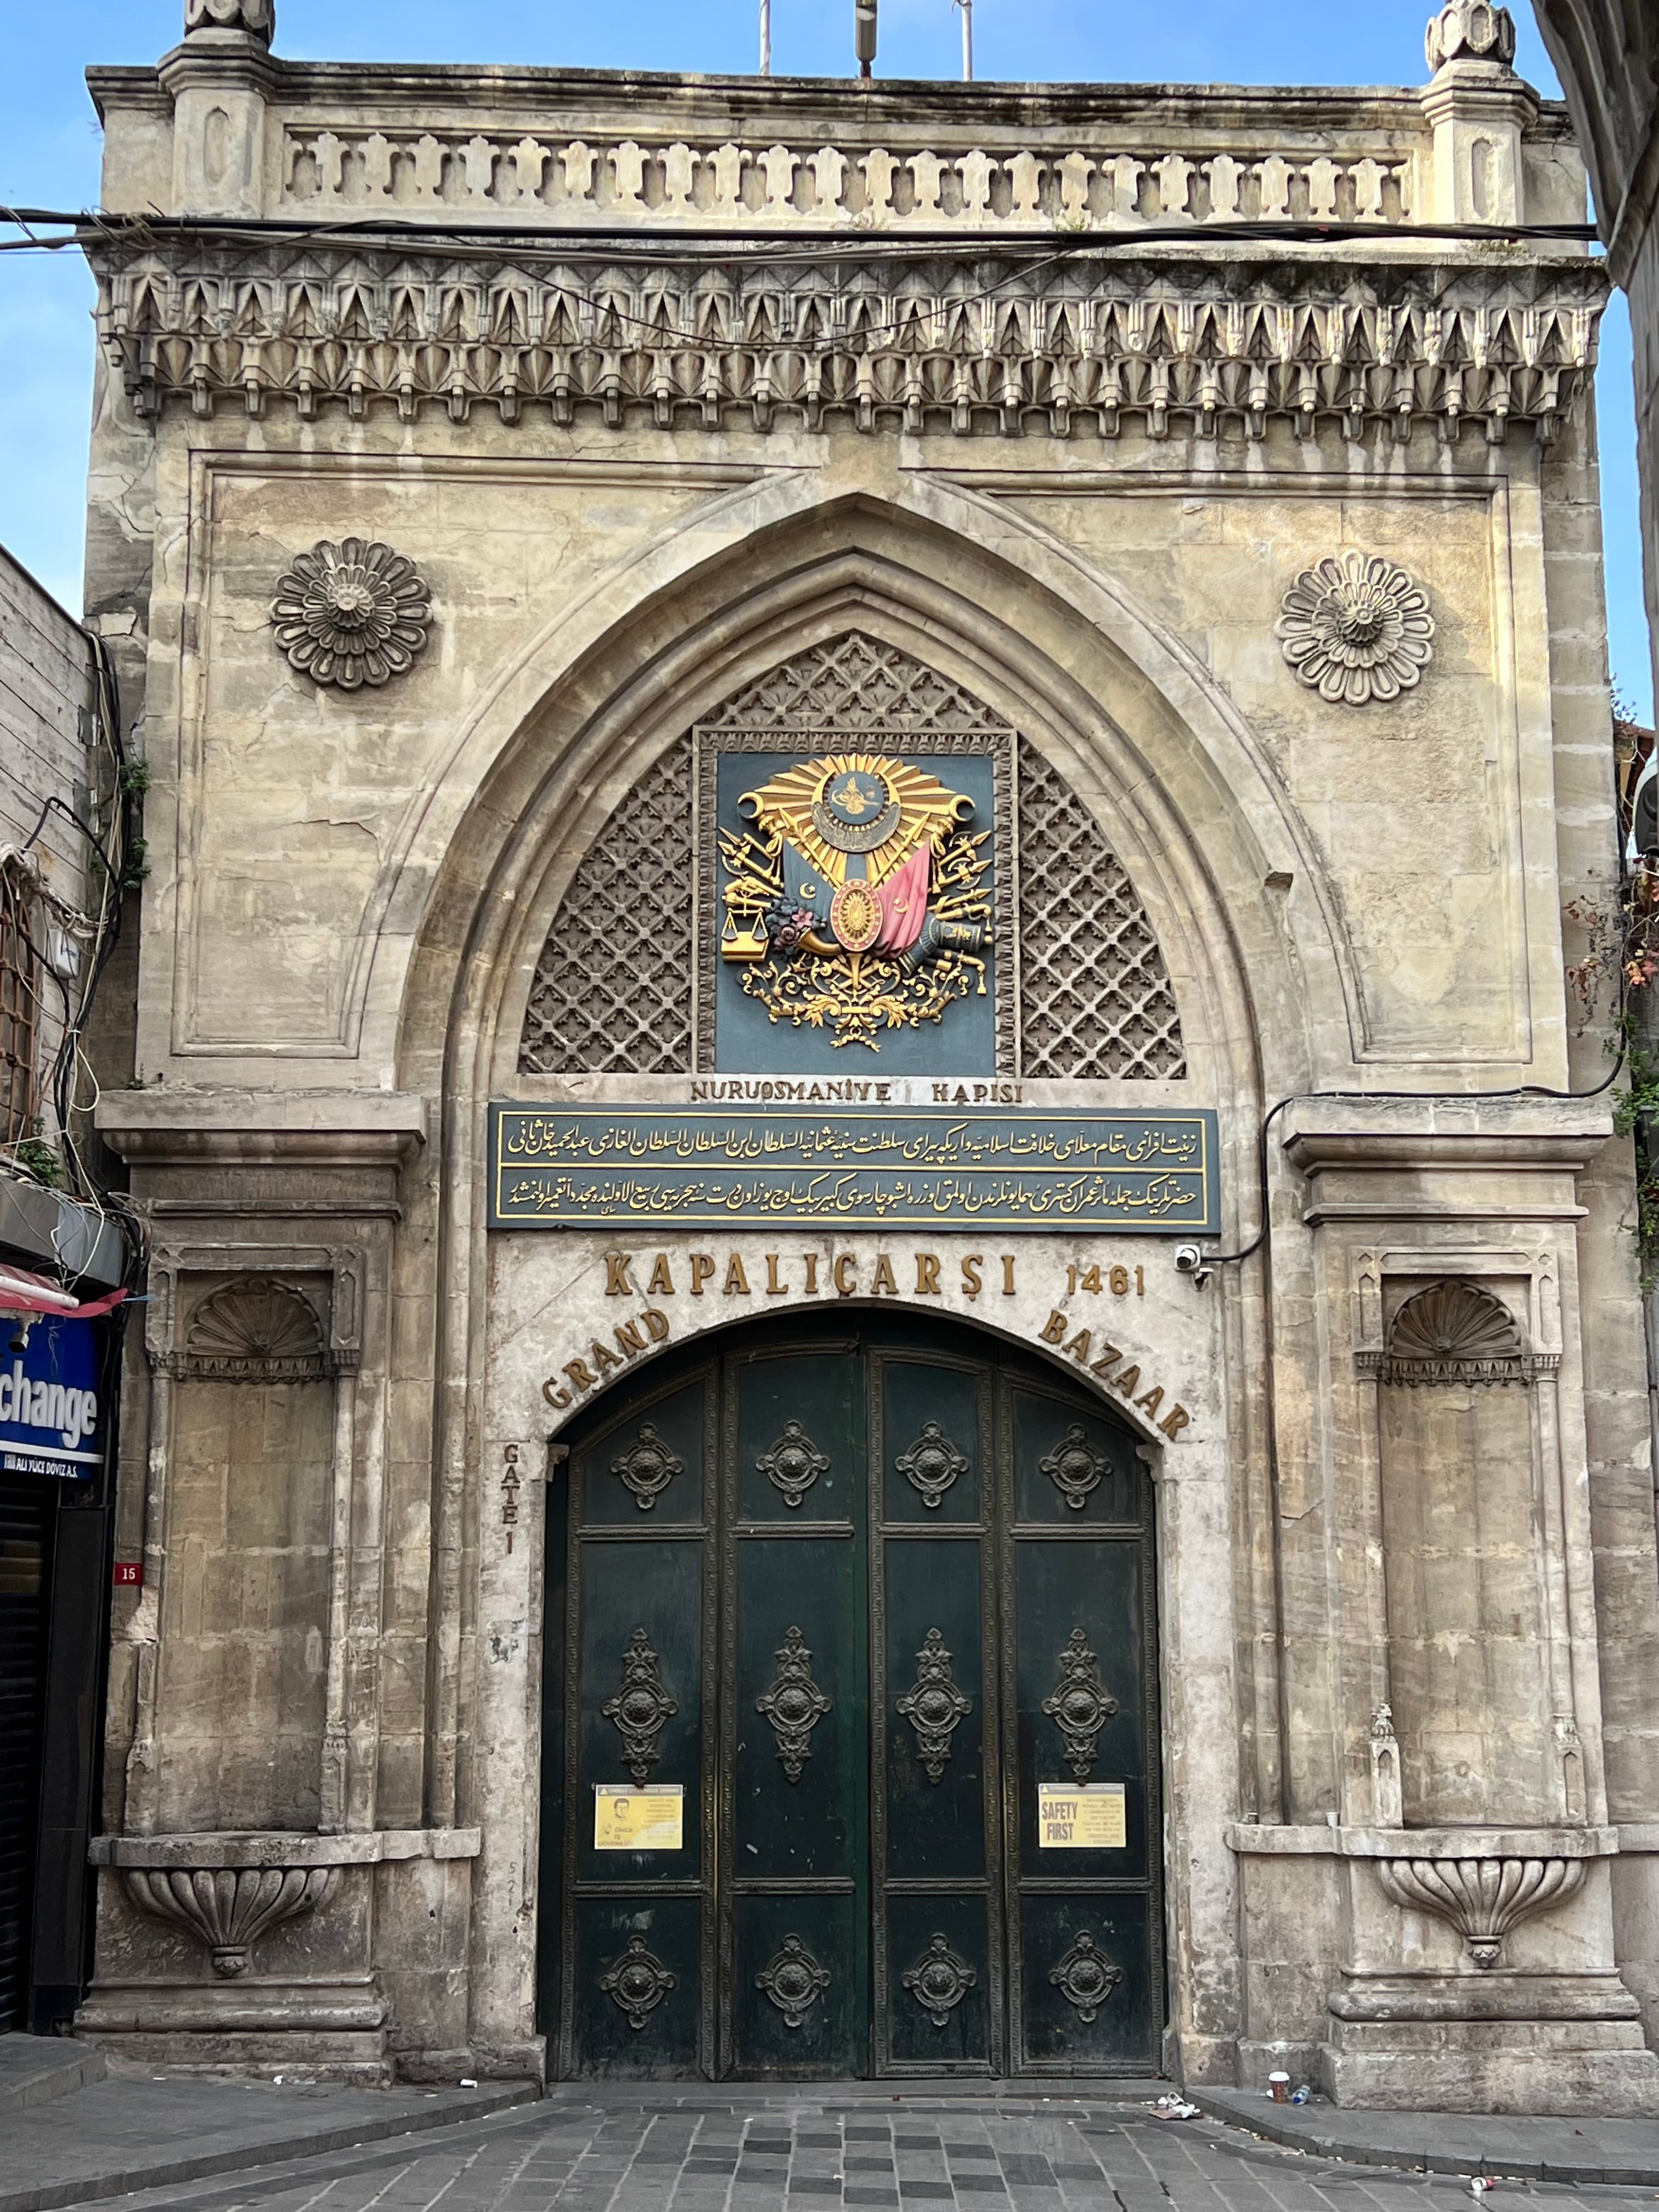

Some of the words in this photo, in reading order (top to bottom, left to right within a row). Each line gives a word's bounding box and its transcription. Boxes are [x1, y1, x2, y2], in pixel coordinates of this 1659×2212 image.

[690, 1077, 891, 1101] NURUOSMANİYE
[932, 1083, 1023, 1103] KAPISI
[1067, 1264, 1144, 1296] 1461
[541, 1308, 670, 1409] GRAND
[1037, 1309, 1190, 1441] BAZAAR
[501, 1444, 521, 1525] GATE
[122, 1567, 136, 1580] 15
[1042, 1801, 1078, 1820] SAFETY
[1046, 1822, 1074, 1841] FIRST
